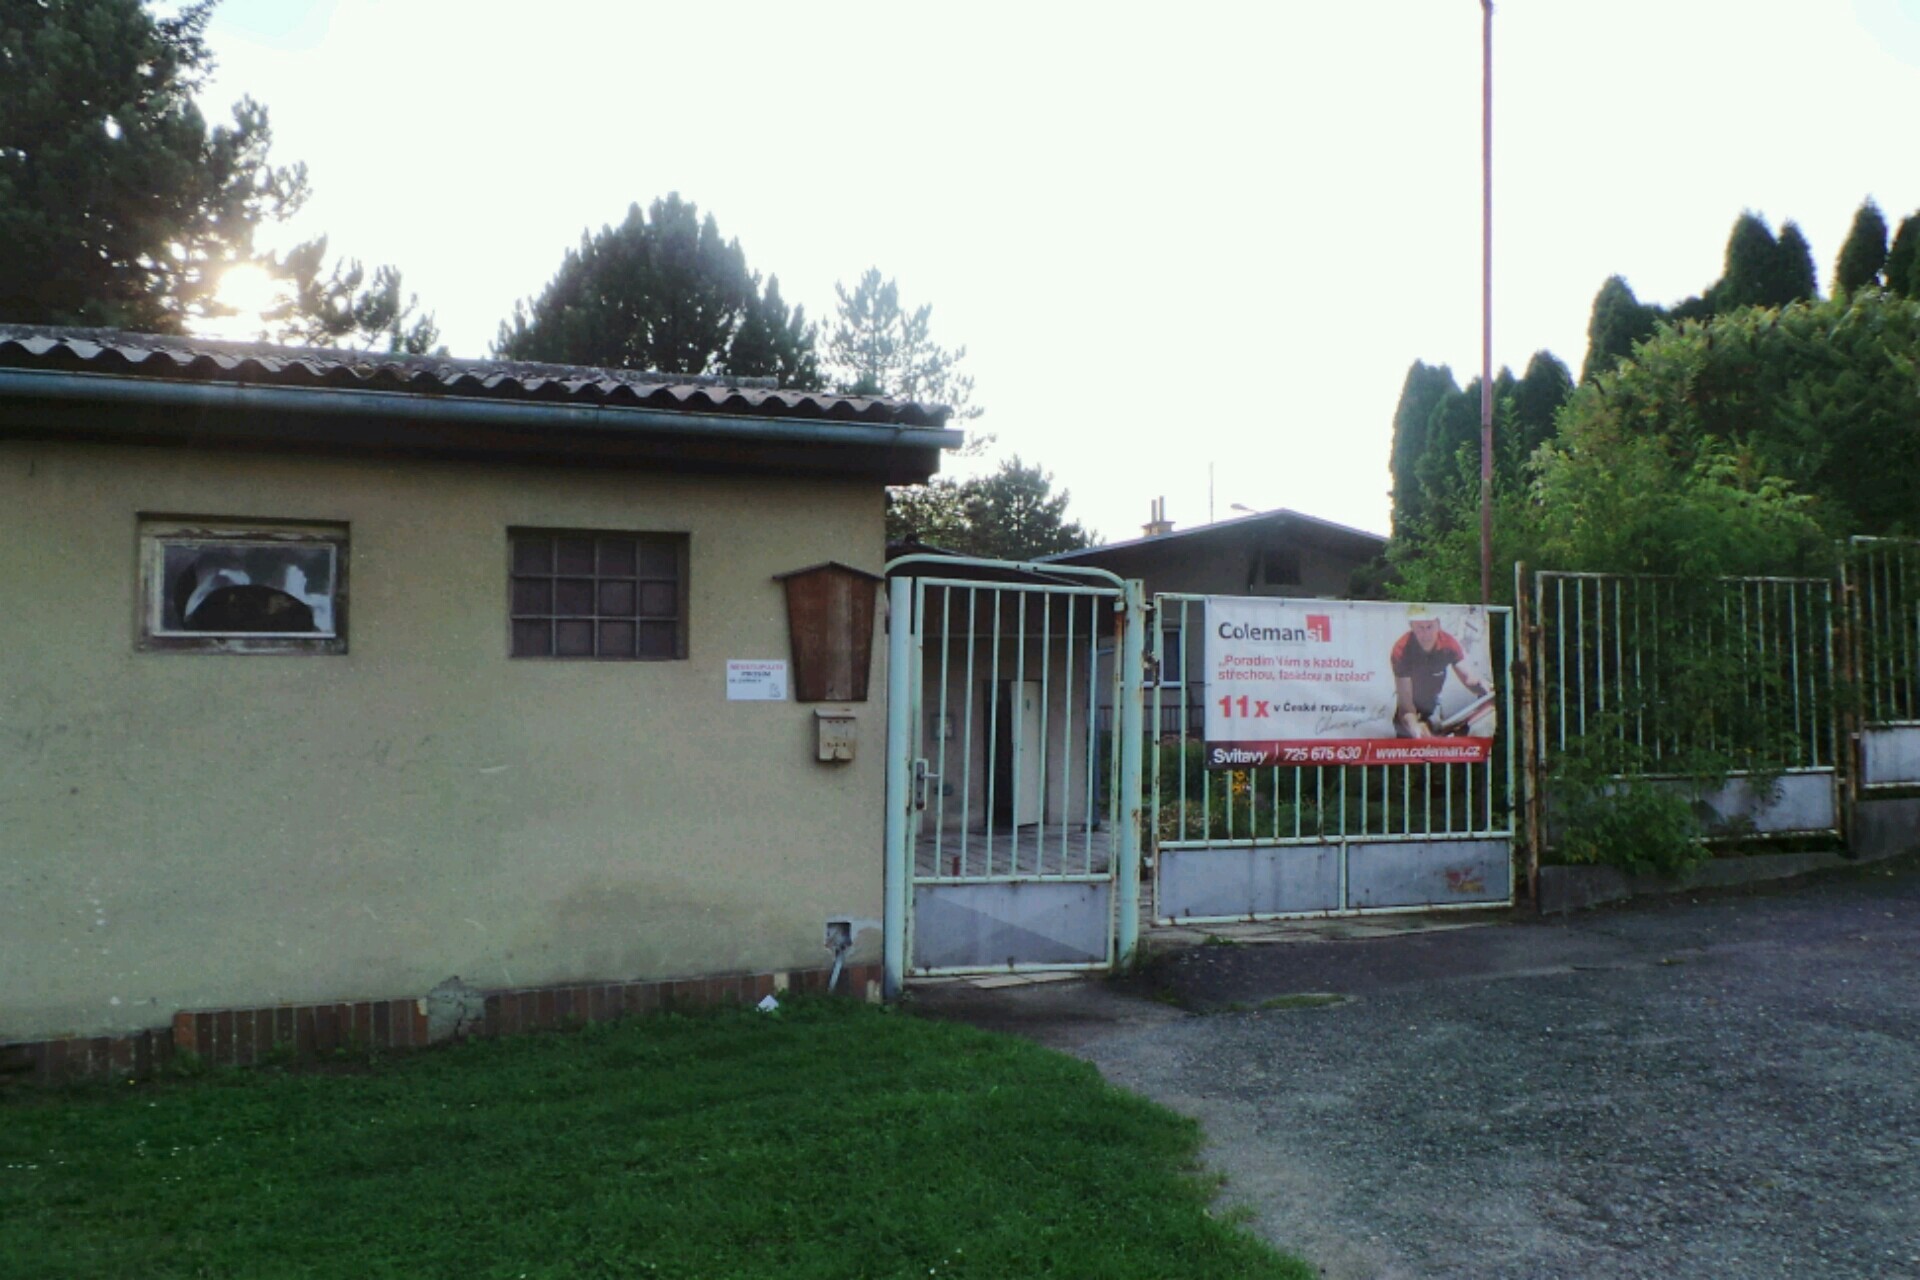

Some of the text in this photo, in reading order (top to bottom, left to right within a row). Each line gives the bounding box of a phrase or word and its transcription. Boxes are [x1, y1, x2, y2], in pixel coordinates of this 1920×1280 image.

[1324, 673, 1333, 682] a
[1213, 747, 1269, 765] Svitavy
[1283, 747, 1308, 761] 725
[1376, 745, 1482, 760] www.coleman.cz
